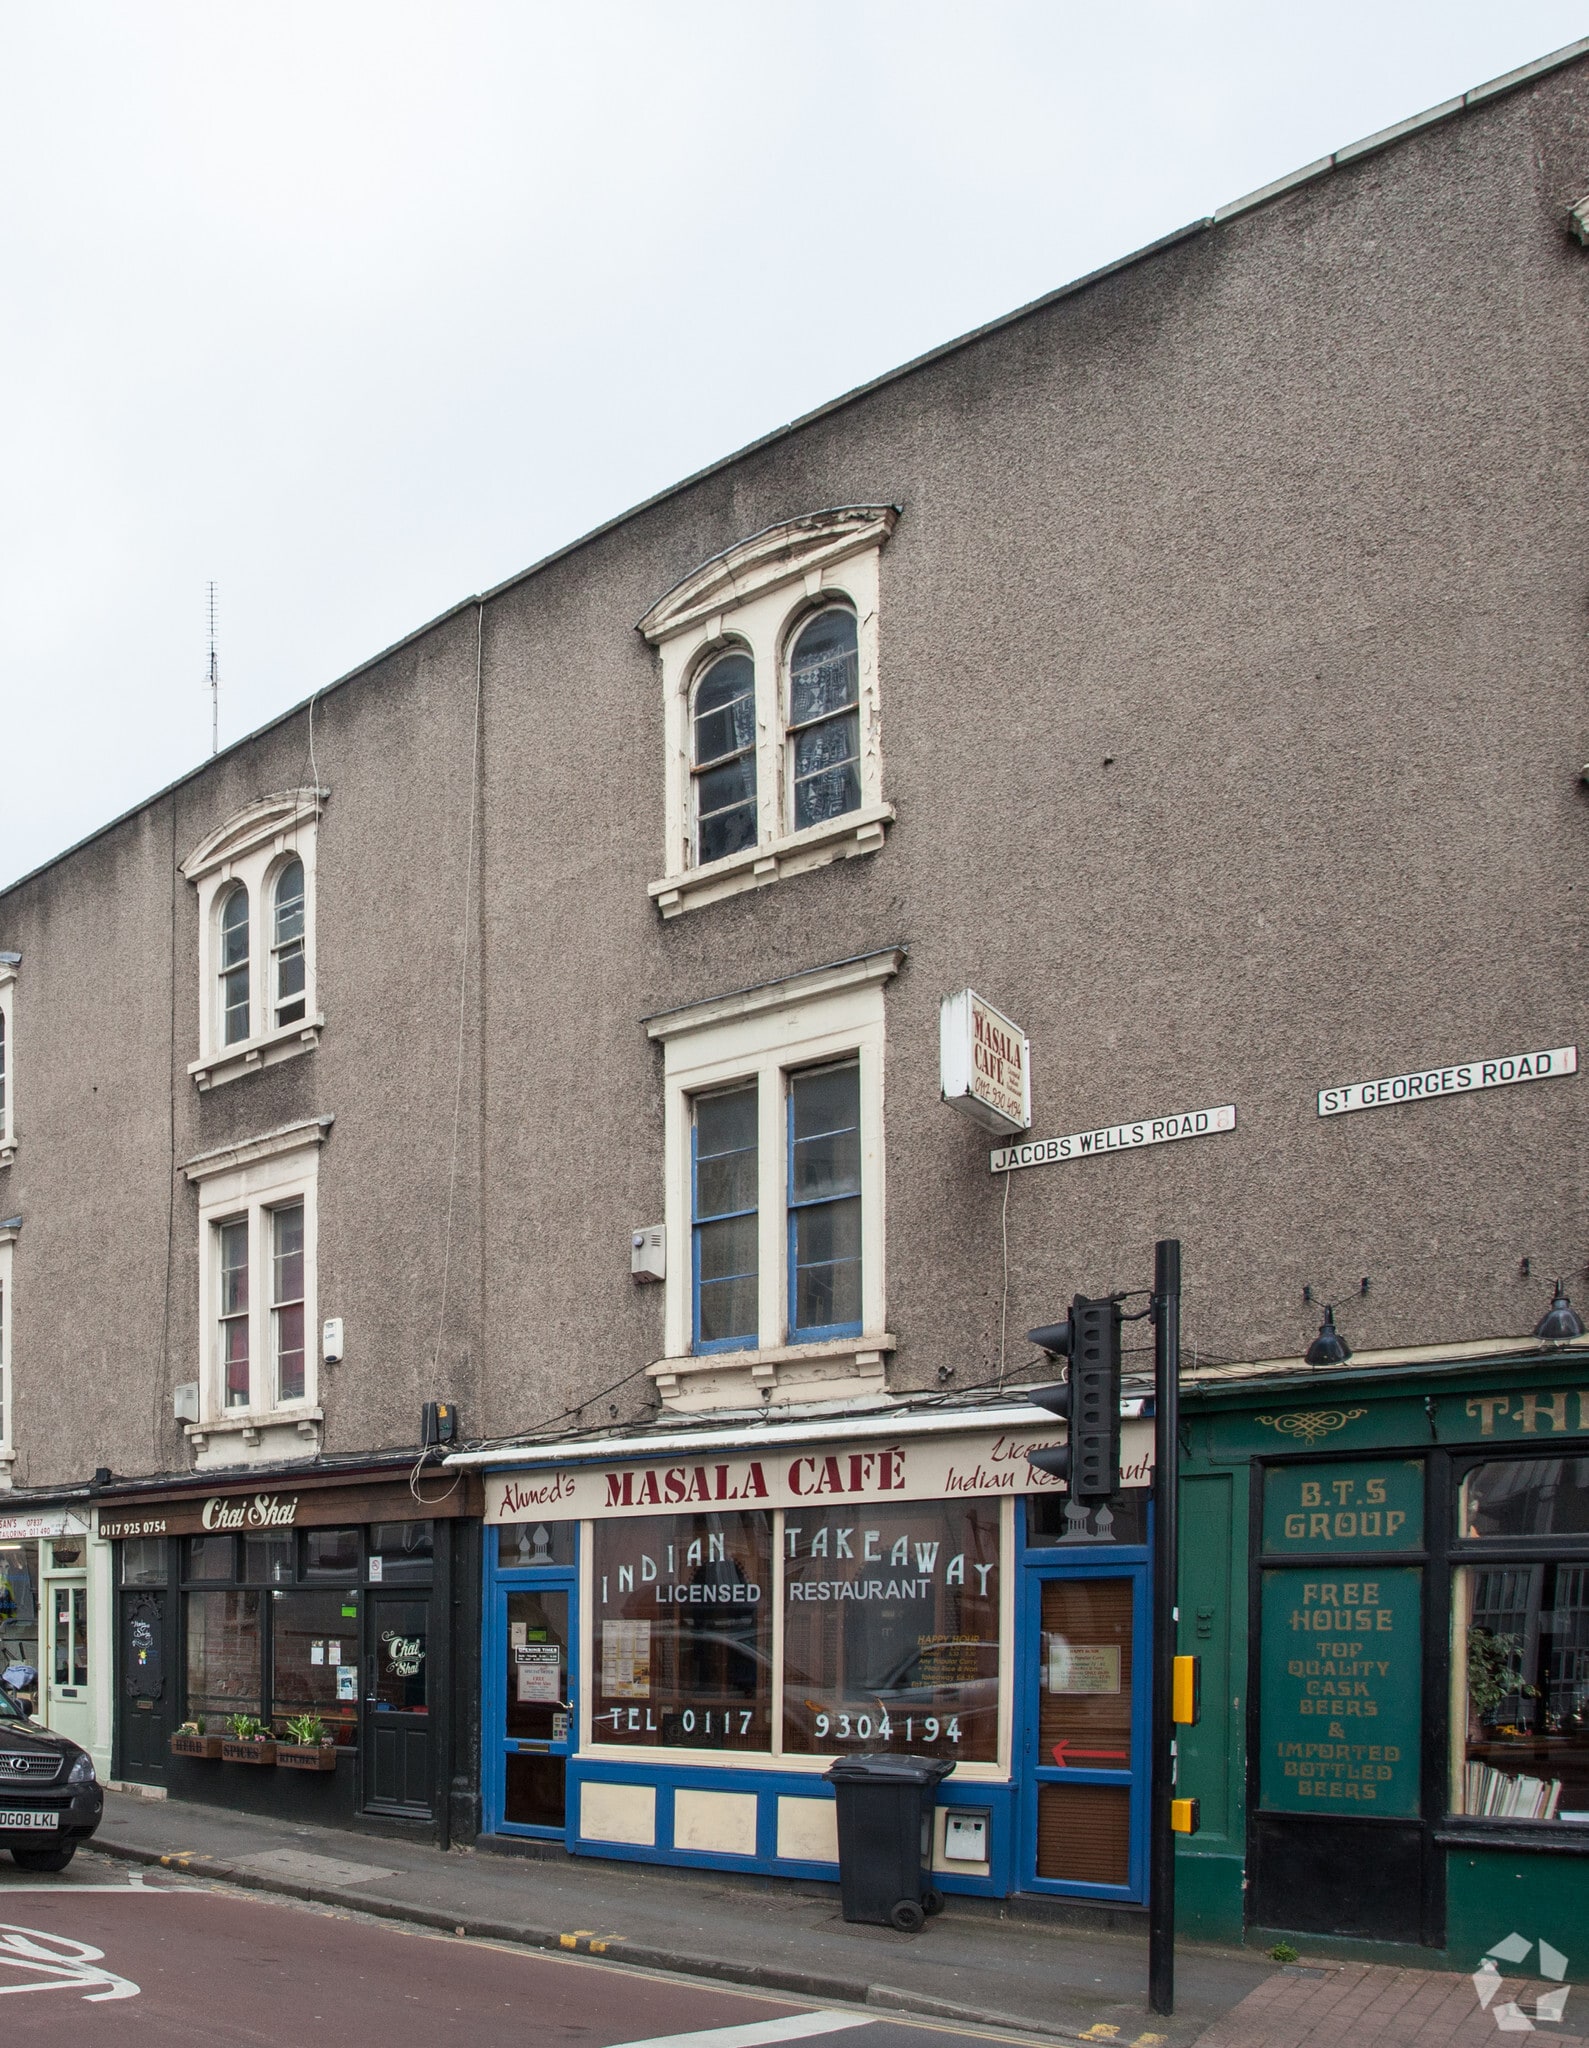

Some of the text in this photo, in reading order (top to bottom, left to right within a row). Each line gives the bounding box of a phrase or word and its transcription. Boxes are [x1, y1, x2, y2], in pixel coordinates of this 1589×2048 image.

[974, 1012, 1021, 1070] MASALA
[1361, 1067, 1472, 1104] GEORGES
[1482, 1053, 1552, 1084] ROAD
[995, 1139, 1072, 1169] JACOBS
[1080, 1125, 1144, 1154] WELLS
[1152, 1112, 1209, 1141] ROAD
[605, 1446, 906, 1508] MASALA CAFÉ
[945, 1464, 1015, 1493] Indian
[499, 1472, 576, 1517] Ahmed's
[202, 1494, 298, 1530] Chai Shai
[100, 1520, 167, 1536] 0117 925 0754
[1284, 1510, 1406, 1540] GROUP
[602, 1532, 726, 1604] INDIAN
[784, 1527, 994, 1596] TAKEAWAY
[655, 1578, 931, 1604] LICENSED RESTAURANT
[1303, 1583, 1380, 1607] FREE
[1289, 1609, 1393, 1632] HOUSE
[389, 1636, 421, 1659] Chai
[917, 1634, 980, 1645] HAPPY HOUR
[1316, 1642, 1364, 1658] TOP
[394, 1660, 420, 1677] Shai
[1288, 1660, 1390, 1678] QUALITY
[1306, 1680, 1370, 1697] CASK
[1299, 1699, 1379, 1717] BEERS
[610, 1707, 962, 1743] TEL 0117 9304194
[1328, 1721, 1345, 1739] &
[1277, 1742, 1401, 1762] IMPORTED
[1284, 1761, 1393, 1781] BOTTLED
[1298, 1781, 1377, 1800] BEERS
[34, 1813, 57, 1827] LKL
